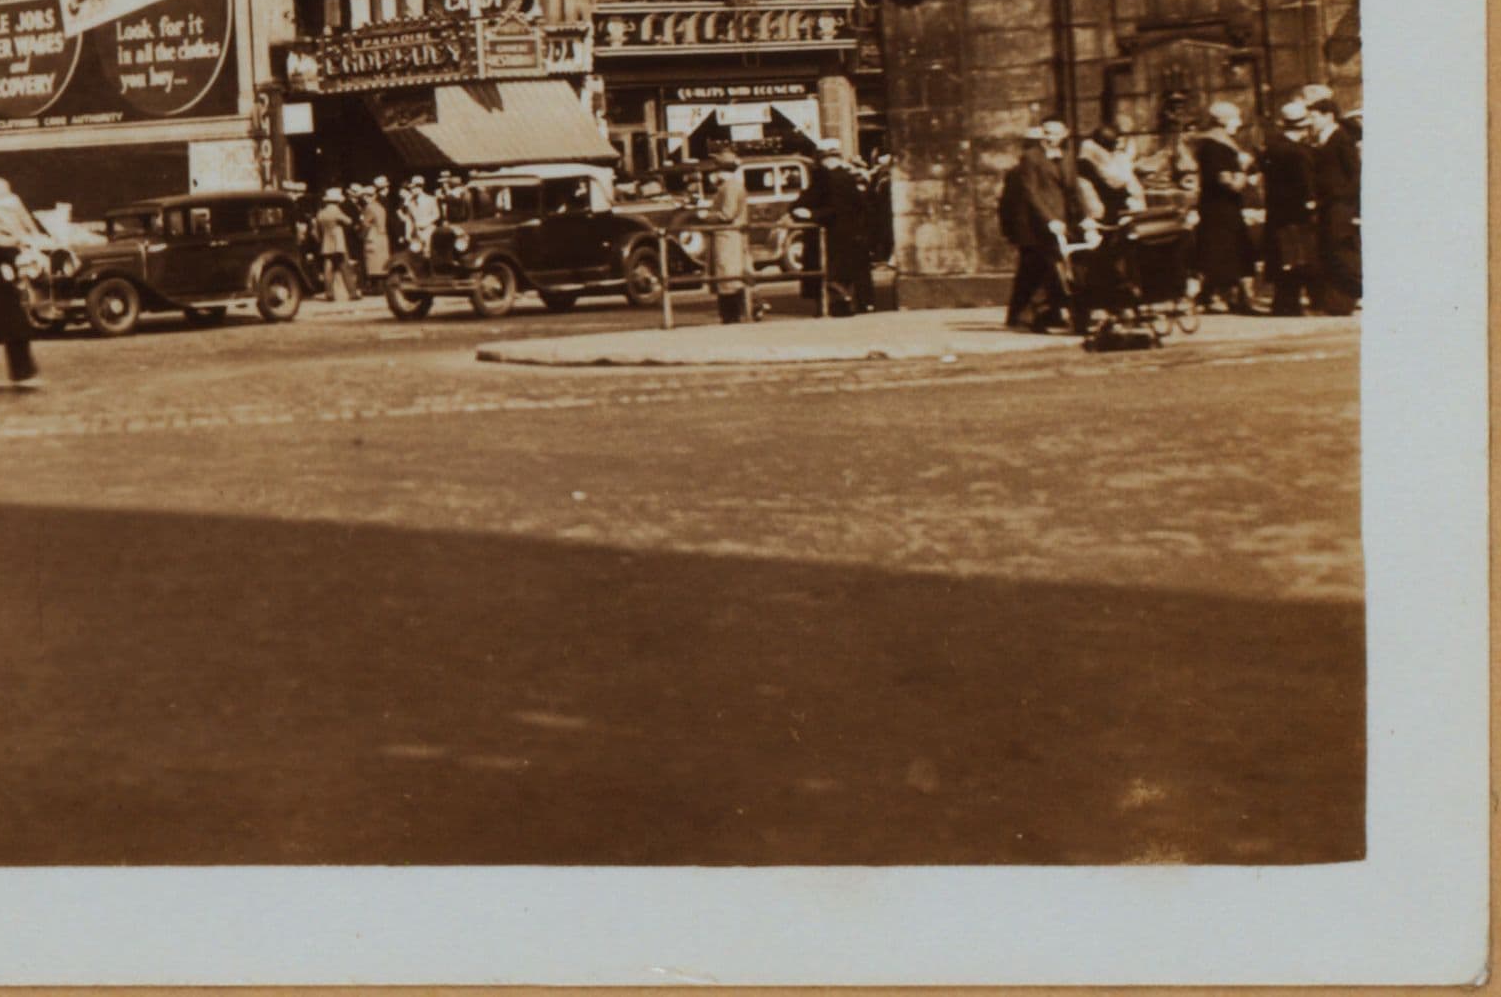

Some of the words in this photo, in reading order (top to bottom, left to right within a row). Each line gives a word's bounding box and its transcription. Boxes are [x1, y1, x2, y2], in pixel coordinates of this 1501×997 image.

[15, 8, 55, 33] JOBS
[116, 17, 155, 42] Look
[159, 14, 185, 37] for
[188, 13, 204, 35] it
[14, 31, 65, 56] WAGES
[135, 41, 154, 64] all
[155, 41, 177, 62] the
[177, 37, 221, 60] clothes
[120, 72, 147, 95] you
[71, 111, 124, 125] AUTHORITY
